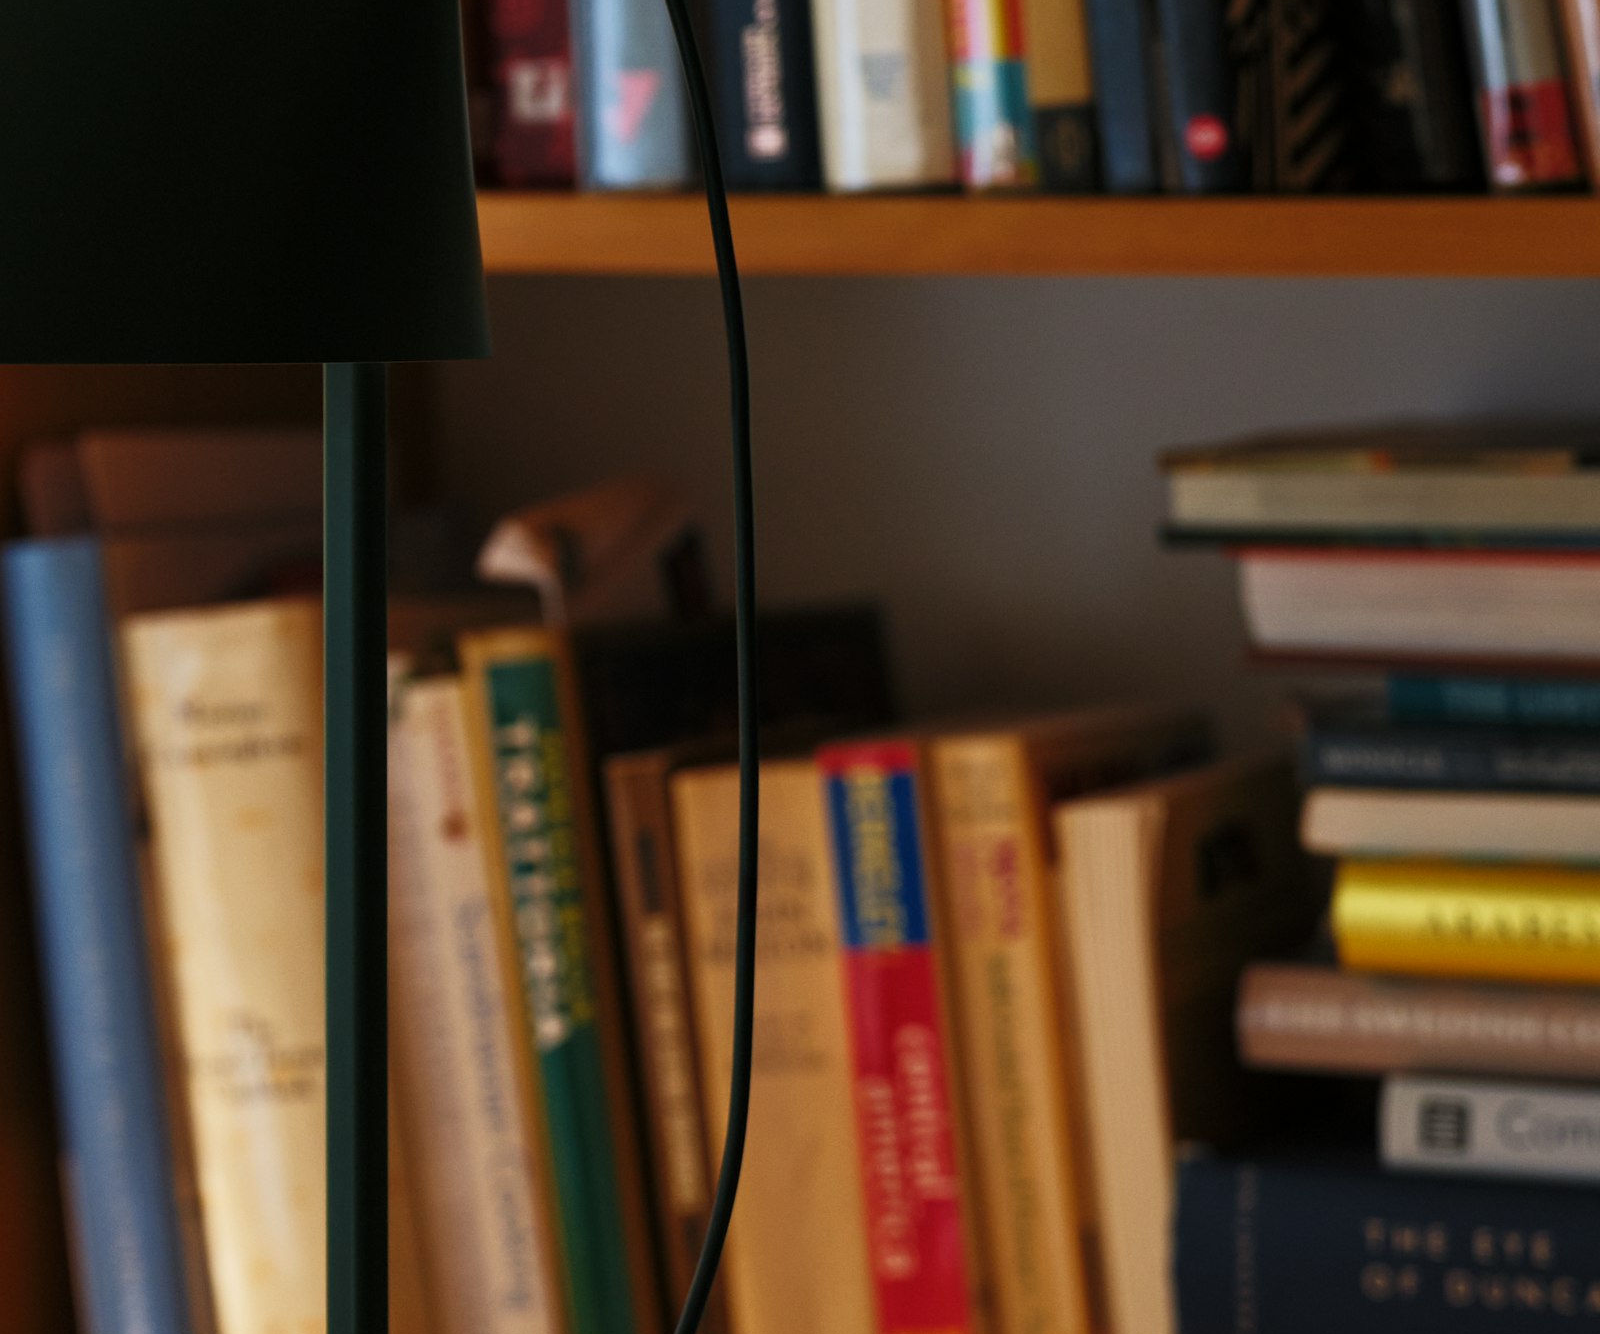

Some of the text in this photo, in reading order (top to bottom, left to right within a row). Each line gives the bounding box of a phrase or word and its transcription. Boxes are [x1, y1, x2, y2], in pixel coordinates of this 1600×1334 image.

[1363, 1216, 1556, 1268] THE EYE
[1361, 1262, 1425, 1303] OF
